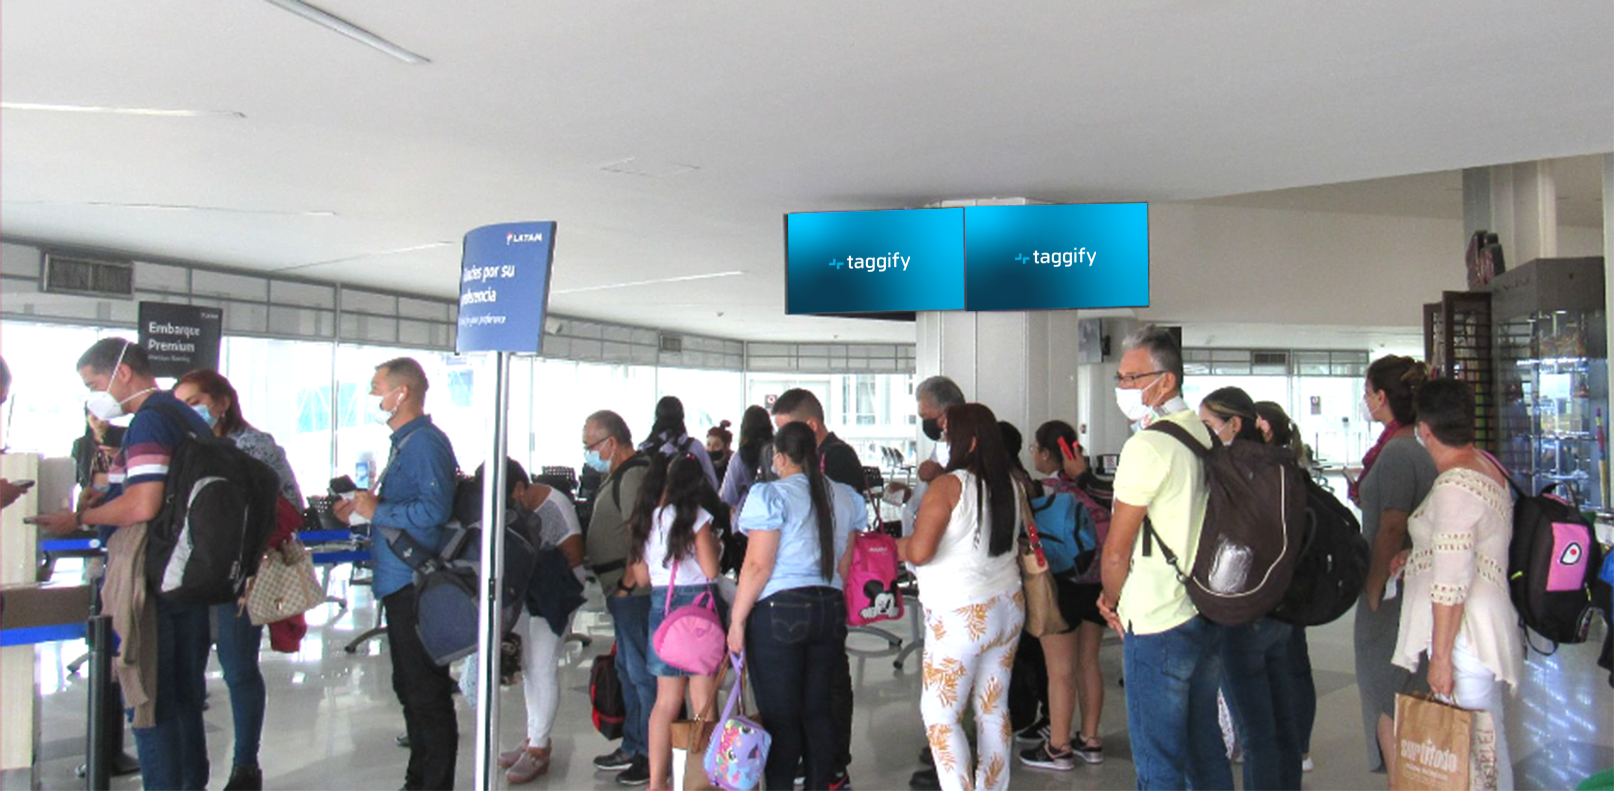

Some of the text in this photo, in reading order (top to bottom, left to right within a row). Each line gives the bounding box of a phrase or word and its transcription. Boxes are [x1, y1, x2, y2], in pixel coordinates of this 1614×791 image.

[513, 233, 542, 243] LATAM
[846, 252, 911, 273] taggify
[1032, 247, 1097, 267] taggify
[149, 321, 200, 339] Embarque
